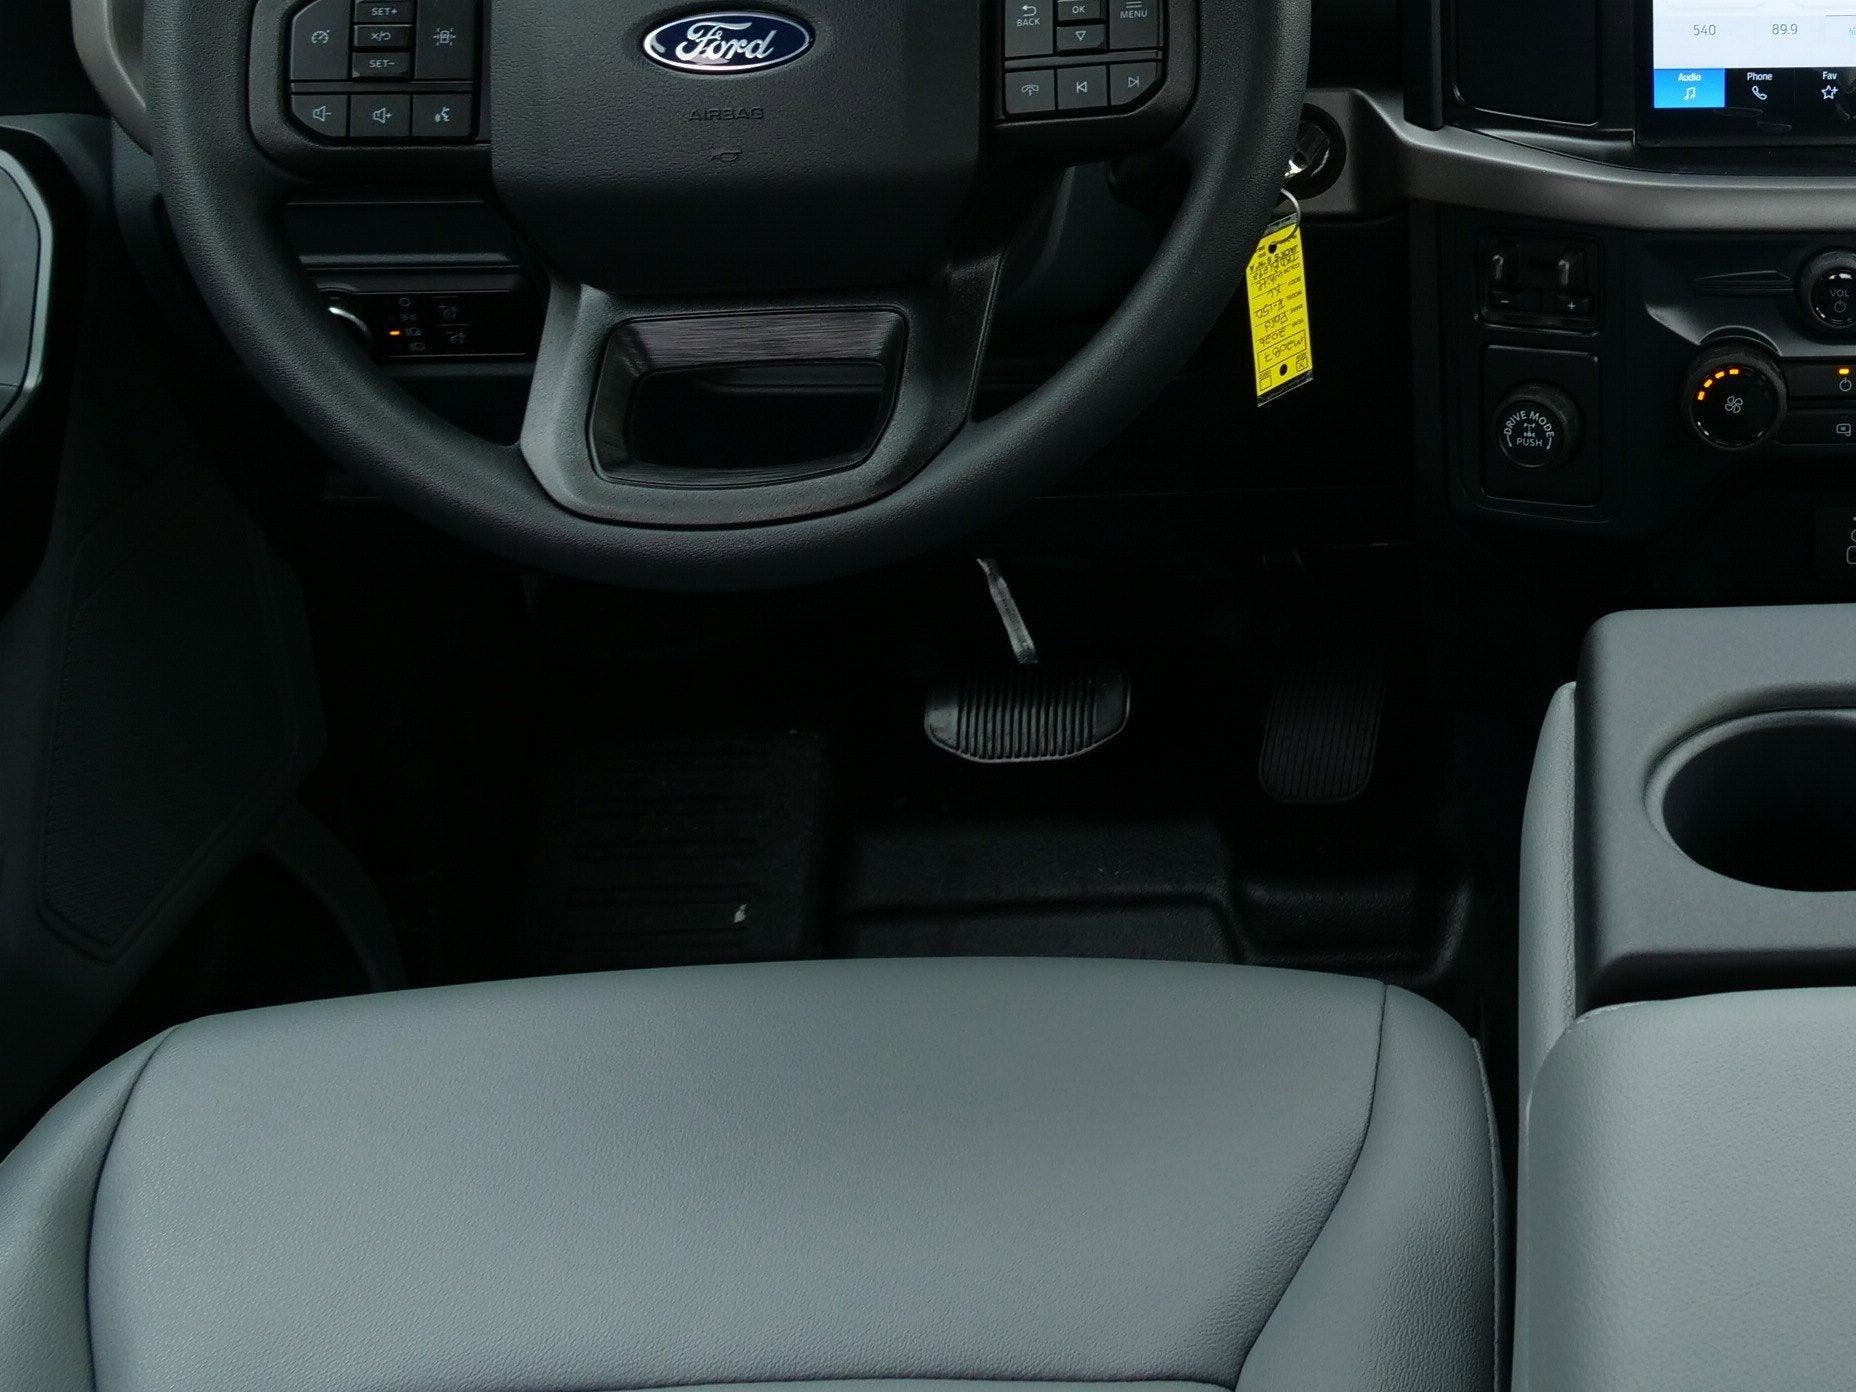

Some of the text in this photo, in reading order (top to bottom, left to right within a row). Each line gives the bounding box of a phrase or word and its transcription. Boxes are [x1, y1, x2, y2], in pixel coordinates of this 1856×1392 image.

[371, 8, 398, 16] SET+
[1072, 6, 1085, 14] OK
[1120, 10, 1148, 18] MENU
[1016, 18, 1040, 27] BACK
[1693, 24, 1716, 36] 540
[1772, 23, 1798, 35] 89.9
[675, 21, 778, 60] Ford
[1678, 72, 1701, 82] Audio
[1747, 72, 1772, 81] Phone
[1822, 71, 1838, 80] Fav
[688, 107, 764, 122] AIRBAG
[1830, 289, 1850, 298] VOL
[1504, 410, 1555, 438] DRIVE MODE
[1516, 438, 1542, 447] PUSH
